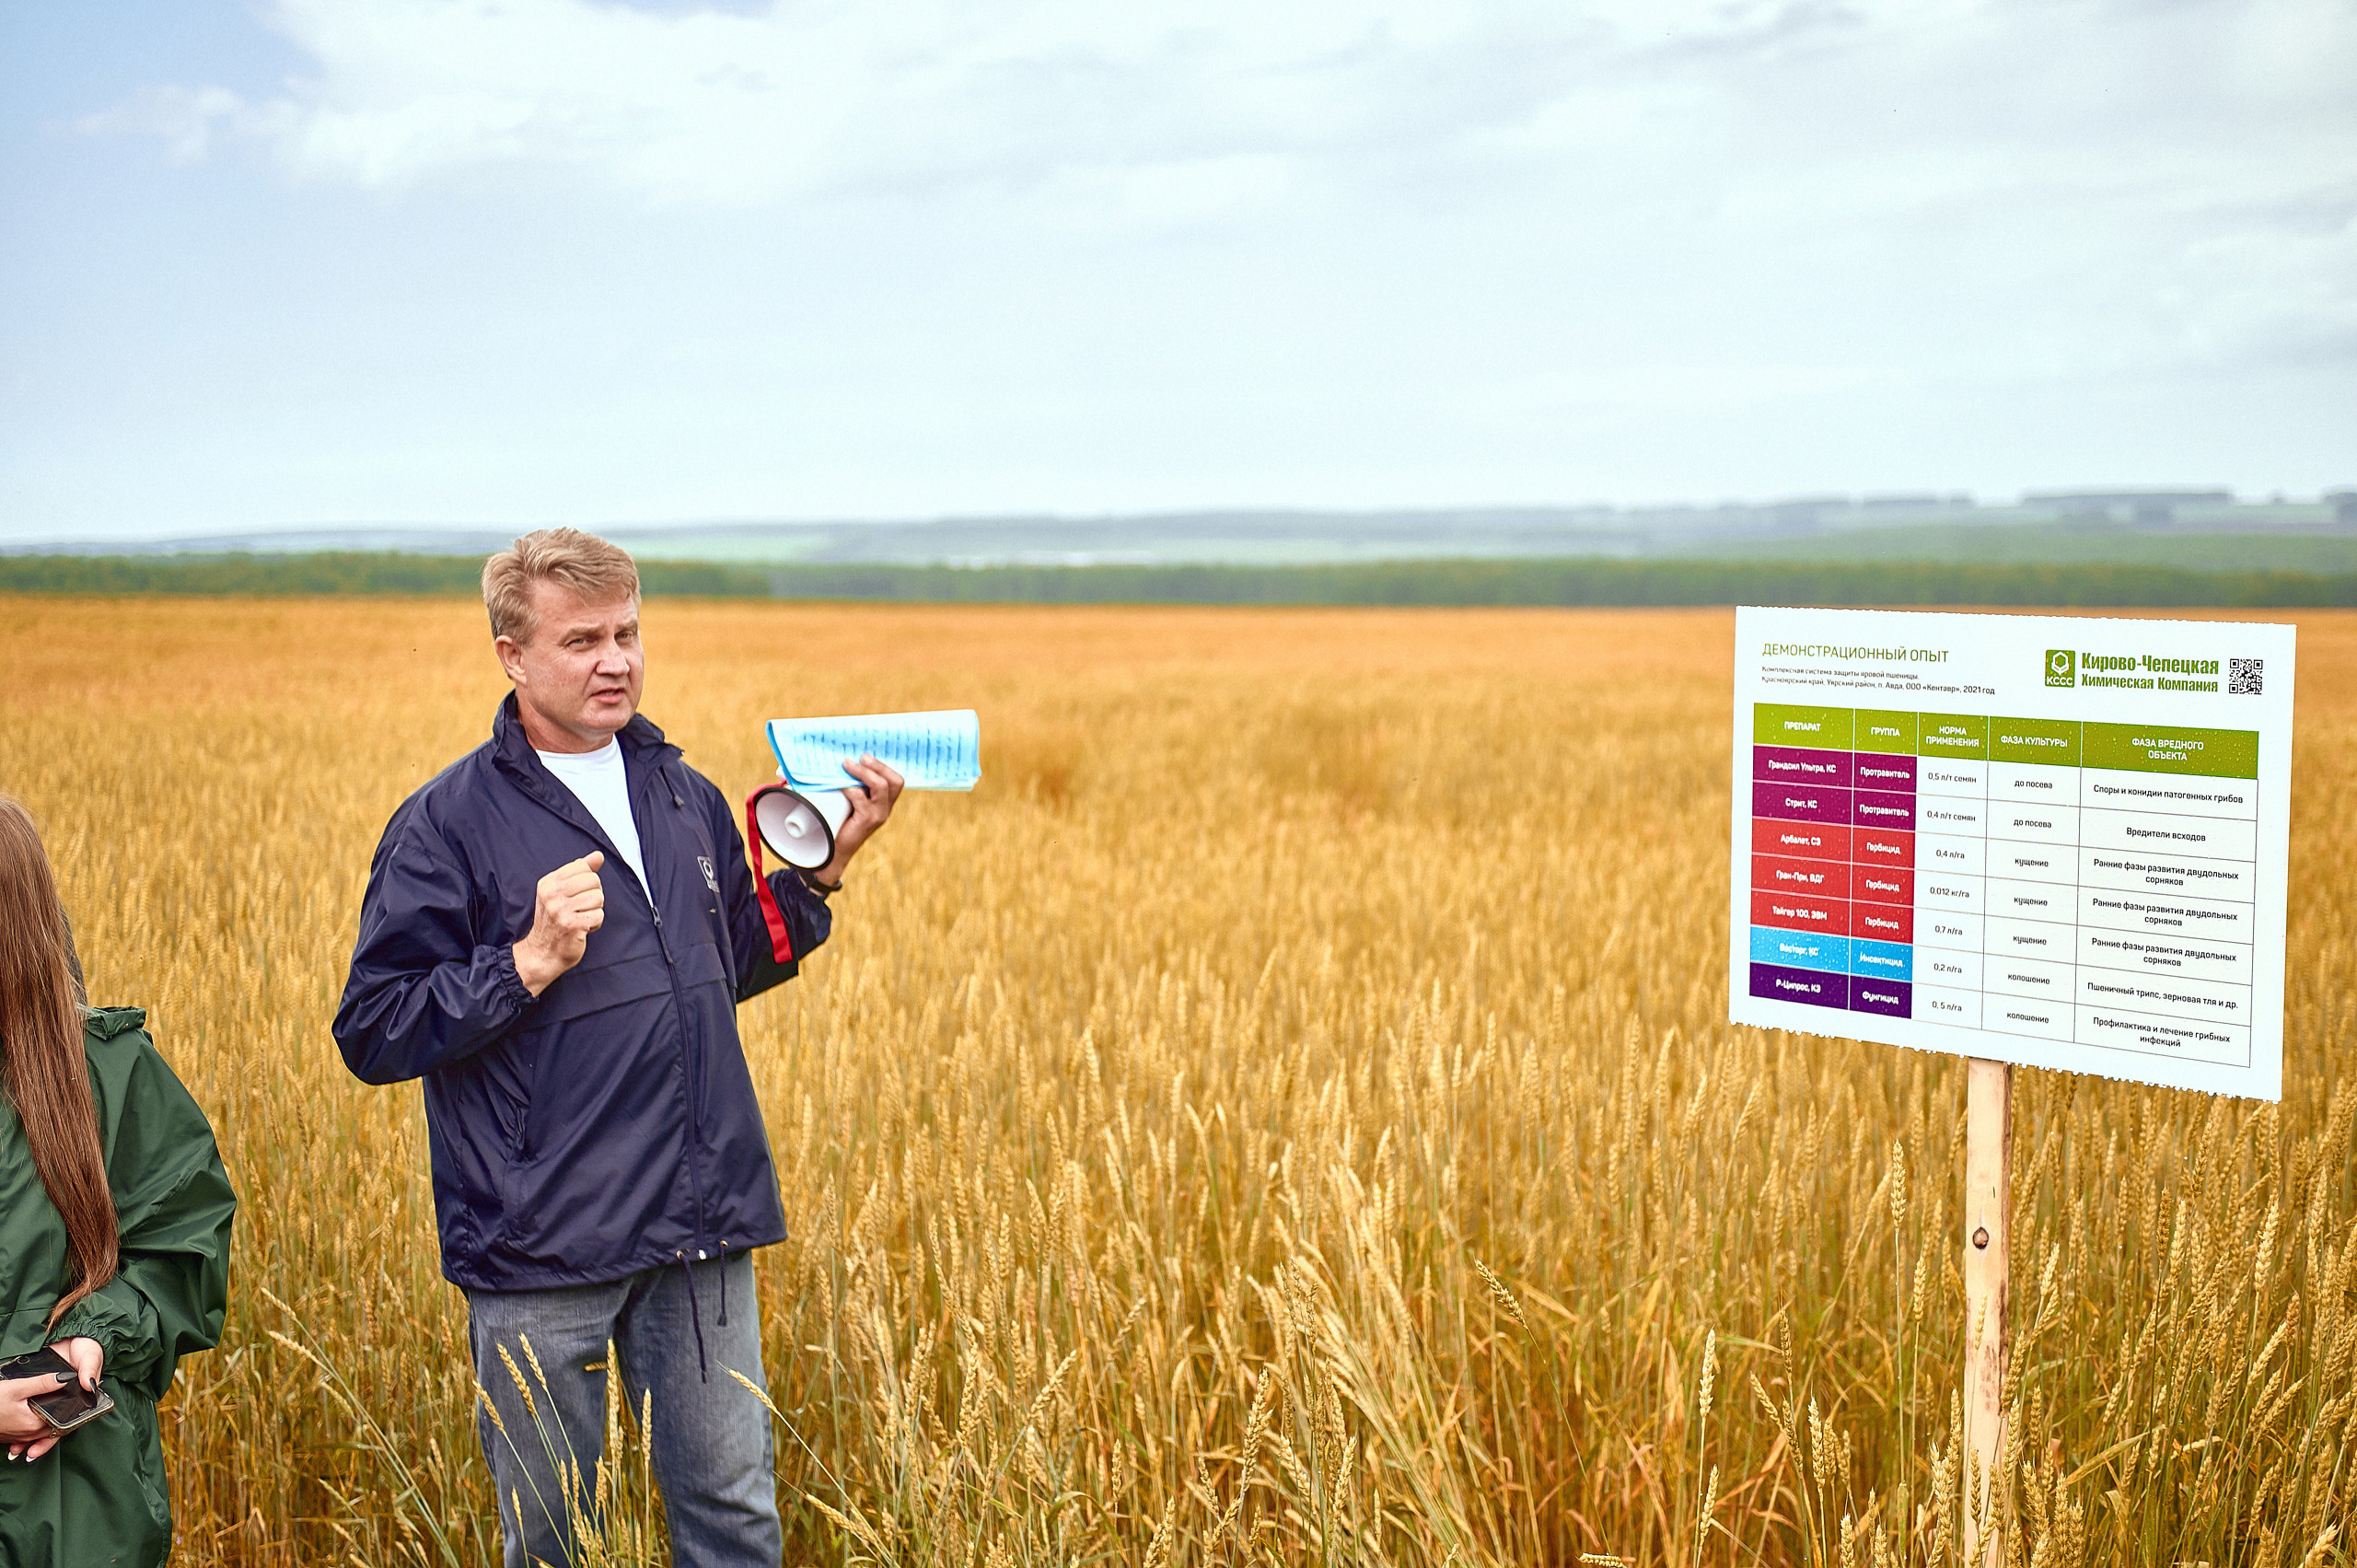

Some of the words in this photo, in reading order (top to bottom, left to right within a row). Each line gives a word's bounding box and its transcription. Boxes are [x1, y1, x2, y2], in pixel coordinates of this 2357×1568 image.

[1762, 644, 1906, 661] ДЕМОНСТРАЦИОННЫЙ
[1910, 650, 1949, 662] ОПЫТ
[2082, 653, 2219, 676] Кирово-Чепецкая
[1861, 670, 1885, 679] яровой
[2082, 674, 2154, 689] Химическая
[2158, 678, 2218, 691] Компания
[1784, 721, 1821, 732] ПРЕПАРАТ
[1871, 726, 1900, 737] ГРУППА
[1939, 726, 1967, 736] НОРМА
[1926, 736, 1980, 748] ПРИМЕНЕНИЯ
[2001, 736, 2024, 745] ФАЗА
[2026, 737, 2068, 748] КУЛЬТУРЫ
[2132, 738, 2156, 748] ФАЗА
[2158, 739, 2204, 750] ВРЕДНОГО
[2148, 751, 2188, 761] ОБЪЕКТА
[1827, 764, 1836, 772] КС
[1860, 767, 1910, 779] Протравитель
[2094, 784, 2119, 796] Споры
[2128, 788, 2163, 798] конидии
[2164, 791, 2212, 801] патогенных
[2213, 794, 2243, 804] грибов
[1807, 800, 1817, 808] КС
[1860, 804, 1910, 817] Протравитель
[1940, 811, 1952, 820] л/т
[2025, 819, 2051, 828] посева
[2127, 828, 2171, 839] Вредители
[2172, 831, 2206, 842] всходов
[1811, 837, 1821, 845] СЭ
[1866, 842, 1900, 854] Гербицид
[1949, 851, 1964, 859] л/га
[2014, 858, 2049, 867] кущение
[2094, 858, 2123, 868] Ранние
[2124, 862, 2145, 872] фазы
[2147, 865, 2185, 875] развития
[2186, 867, 2239, 879] двудольных
[1810, 874, 1824, 884] ВДГ
[2145, 877, 2184, 886] сорняков
[1866, 879, 1899, 891] Гербицид
[1951, 889, 1969, 899] кг/га
[2014, 897, 2048, 906] кущение
[1796, 909, 1810, 919] 100,
[2093, 899, 2121, 909] Ранние
[2123, 901, 2145, 912] фазы
[2146, 904, 2184, 915] развития
[2186, 908, 2237, 921] двудольных
[1865, 916, 1898, 929] Гербицид
[2144, 917, 2182, 926] сорняков
[1947, 927, 1962, 935] л/га
[2013, 935, 2047, 945] кущение
[2092, 937, 2120, 948] Ранние
[2122, 941, 2143, 951] фазы
[2145, 945, 2183, 955] развития
[2184, 948, 2236, 961] двудольных
[2143, 957, 2181, 966] сорняков
[1946, 965, 1962, 974] л/га
[2007, 973, 2049, 984] колошение
[1863, 991, 1898, 1005] Фунгицид
[2088, 982, 2134, 994] Пшеничный
[2136, 990, 2162, 1000] трипс,
[2163, 993, 2200, 1004] зерновая
[2225, 1001, 2238, 1009] др.
[1946, 1004, 1962, 1012] л/га
[2007, 1012, 2049, 1023] колошение
[2094, 1017, 2151, 1032] Профилактика
[2160, 1027, 2194, 1038] лечение
[2195, 1030, 2230, 1042] грибных
[2140, 1036, 2180, 1048] инфекций
